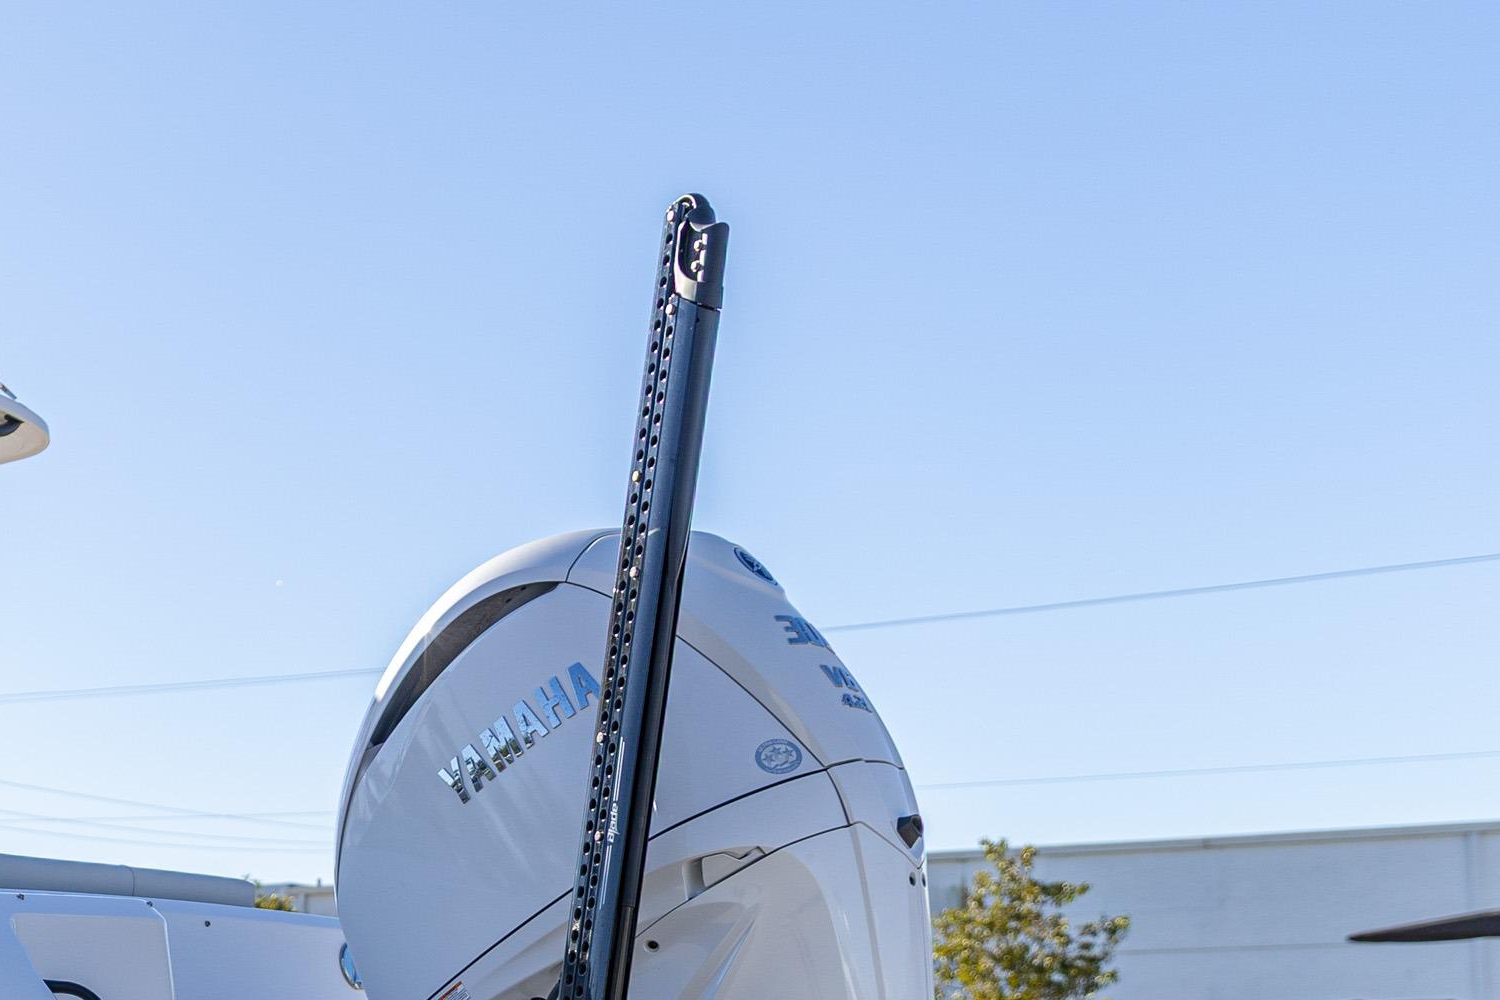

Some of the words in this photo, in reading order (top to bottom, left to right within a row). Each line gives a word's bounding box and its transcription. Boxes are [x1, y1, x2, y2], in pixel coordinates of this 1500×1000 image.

[774, 615, 835, 654] 30
[437, 661, 602, 805] YAMAHA
[606, 802, 620, 843] Blade
